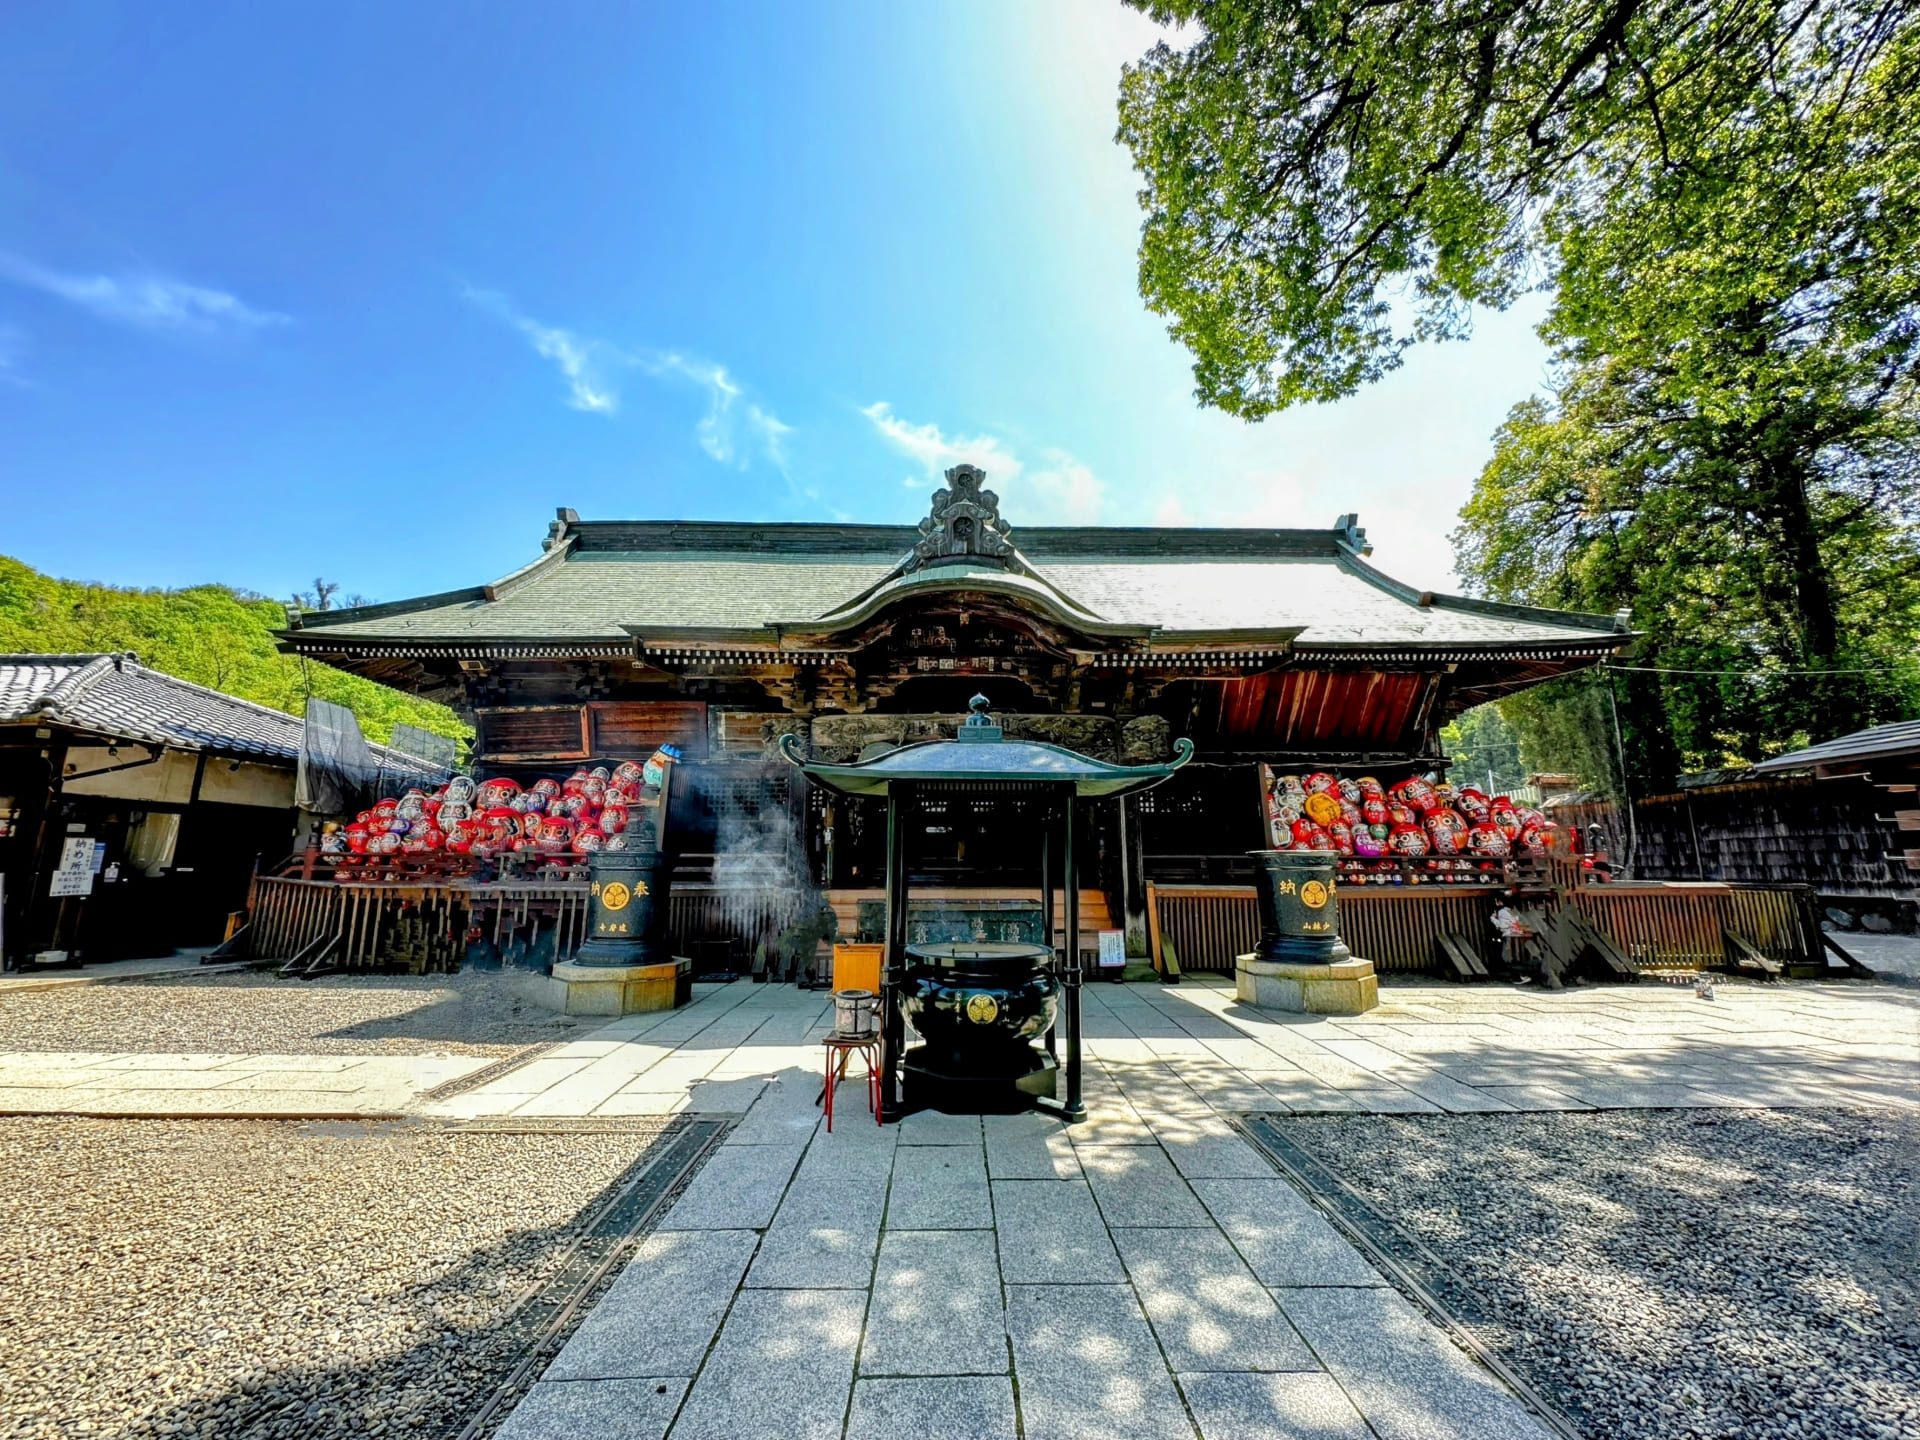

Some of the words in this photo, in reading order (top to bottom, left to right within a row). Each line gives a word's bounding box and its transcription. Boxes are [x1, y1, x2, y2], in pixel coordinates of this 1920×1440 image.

[70, 839, 87, 871] 納め所
[1279, 879, 1296, 896] 納
